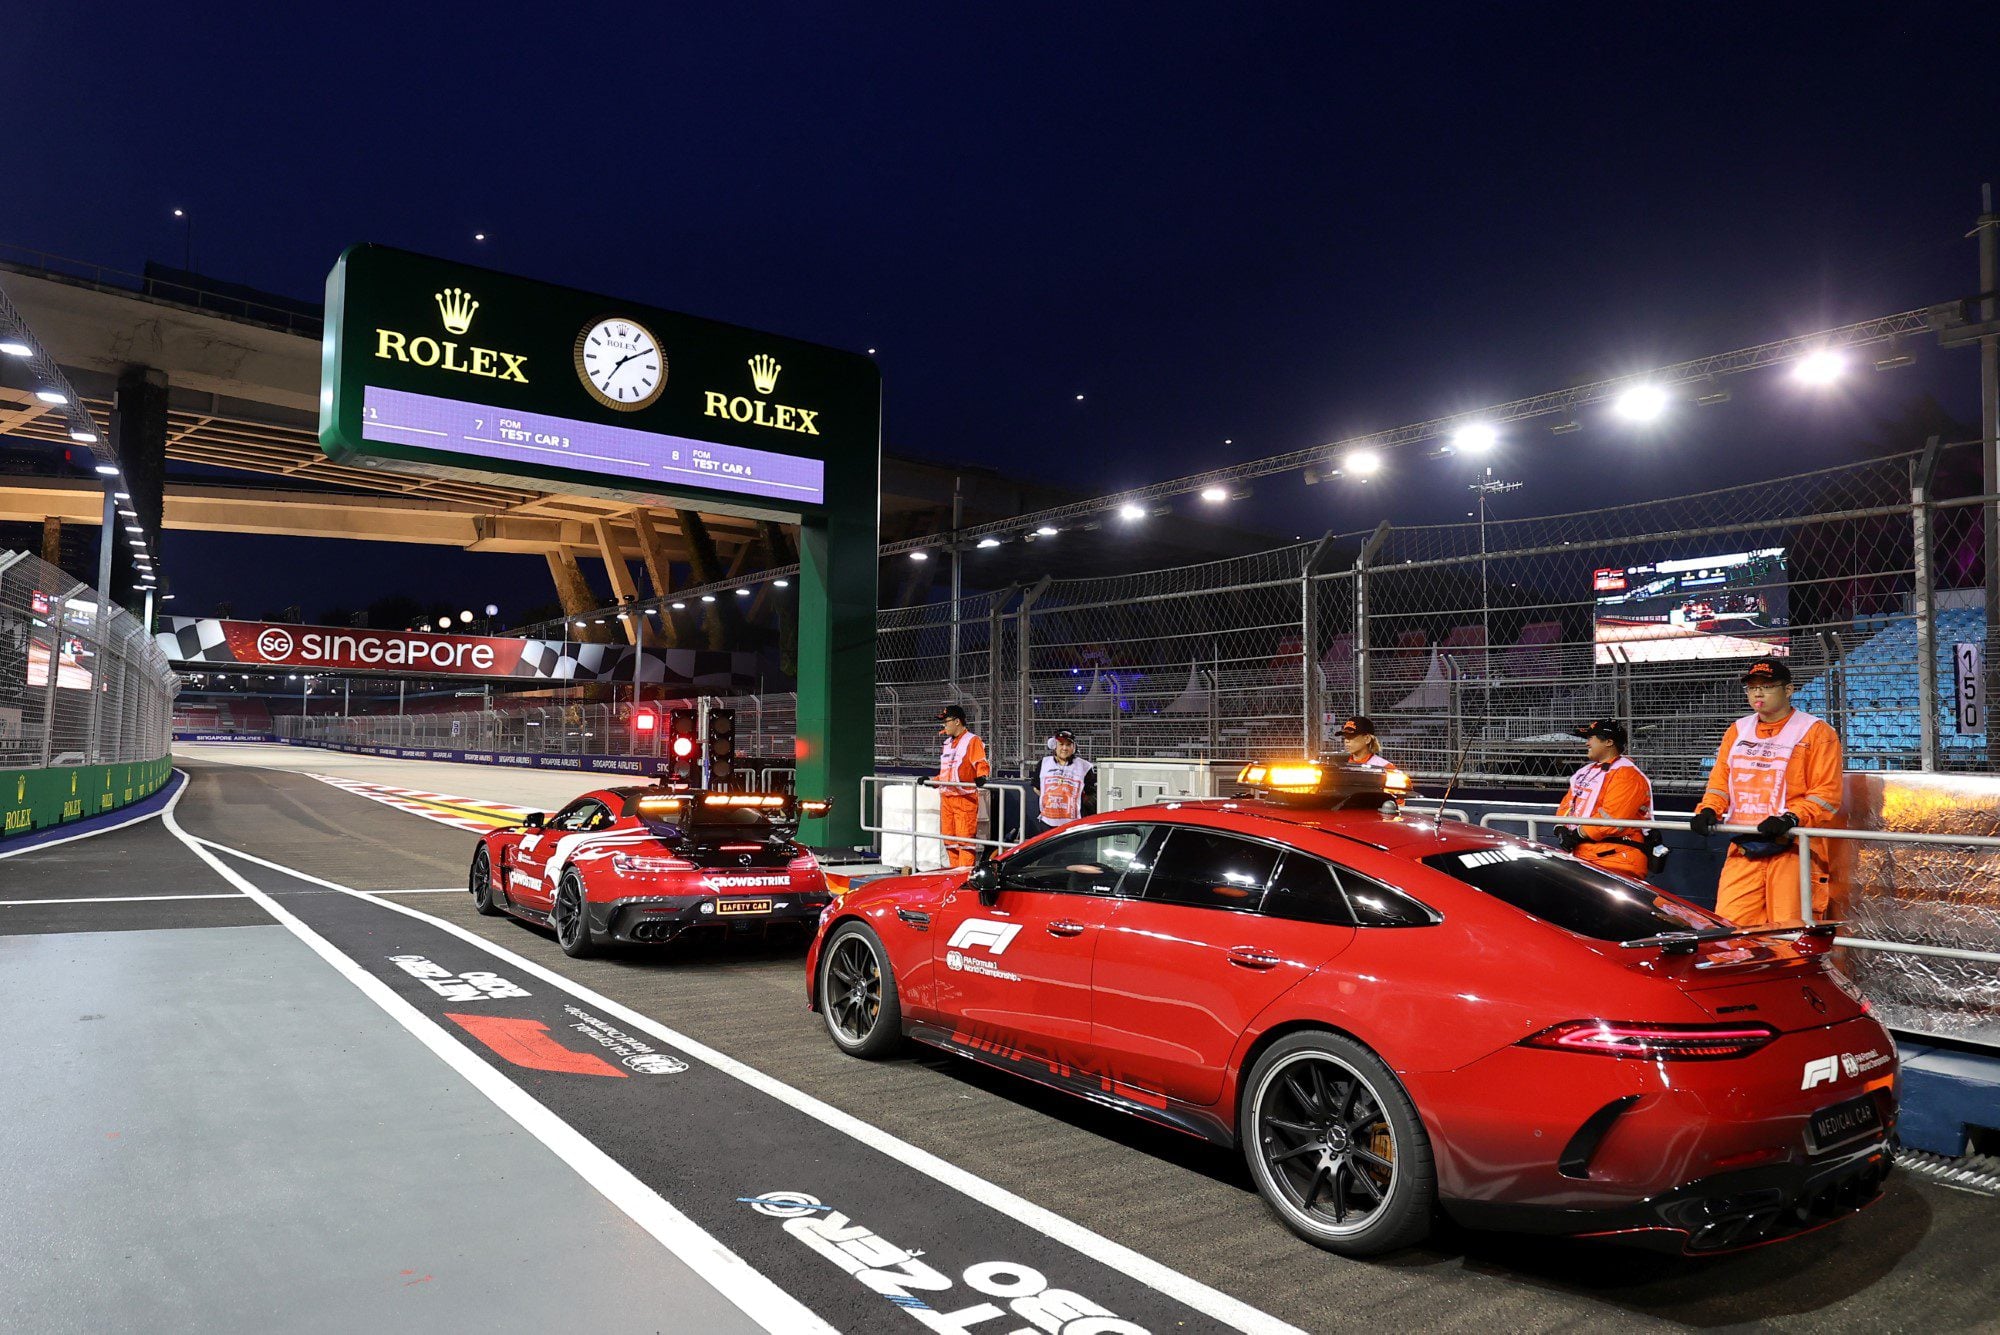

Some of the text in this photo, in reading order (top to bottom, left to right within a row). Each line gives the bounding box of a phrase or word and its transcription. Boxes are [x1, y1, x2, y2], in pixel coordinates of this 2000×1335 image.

[607, 340, 637, 351] ROLEX
[375, 328, 529, 383] ROLEX
[370, 408, 378, 419] 1
[704, 391, 820, 435] ROLEX
[474, 420, 483, 430] 7
[500, 419, 521, 429] FOM
[500, 428, 570, 448] TEST CAR 3
[672, 450, 680, 460] 8
[692, 450, 711, 459] FOM
[692, 458, 752, 476] TEST CAR 4
[262, 637, 289, 652] SG
[1963, 650, 1977, 727] 150
[540, 758, 578, 768] SINGAPORE AIRLINES
[592, 760, 638, 770] SINGAPORE AIRLINES
[64, 800, 82, 818] ROLEX
[5, 808, 31, 830] ROLEX
[712, 876, 790, 888] CROWDSTRIKE
[752, 902, 768, 910] CAR
[1818, 1106, 1873, 1137] MEDICAL CAR
